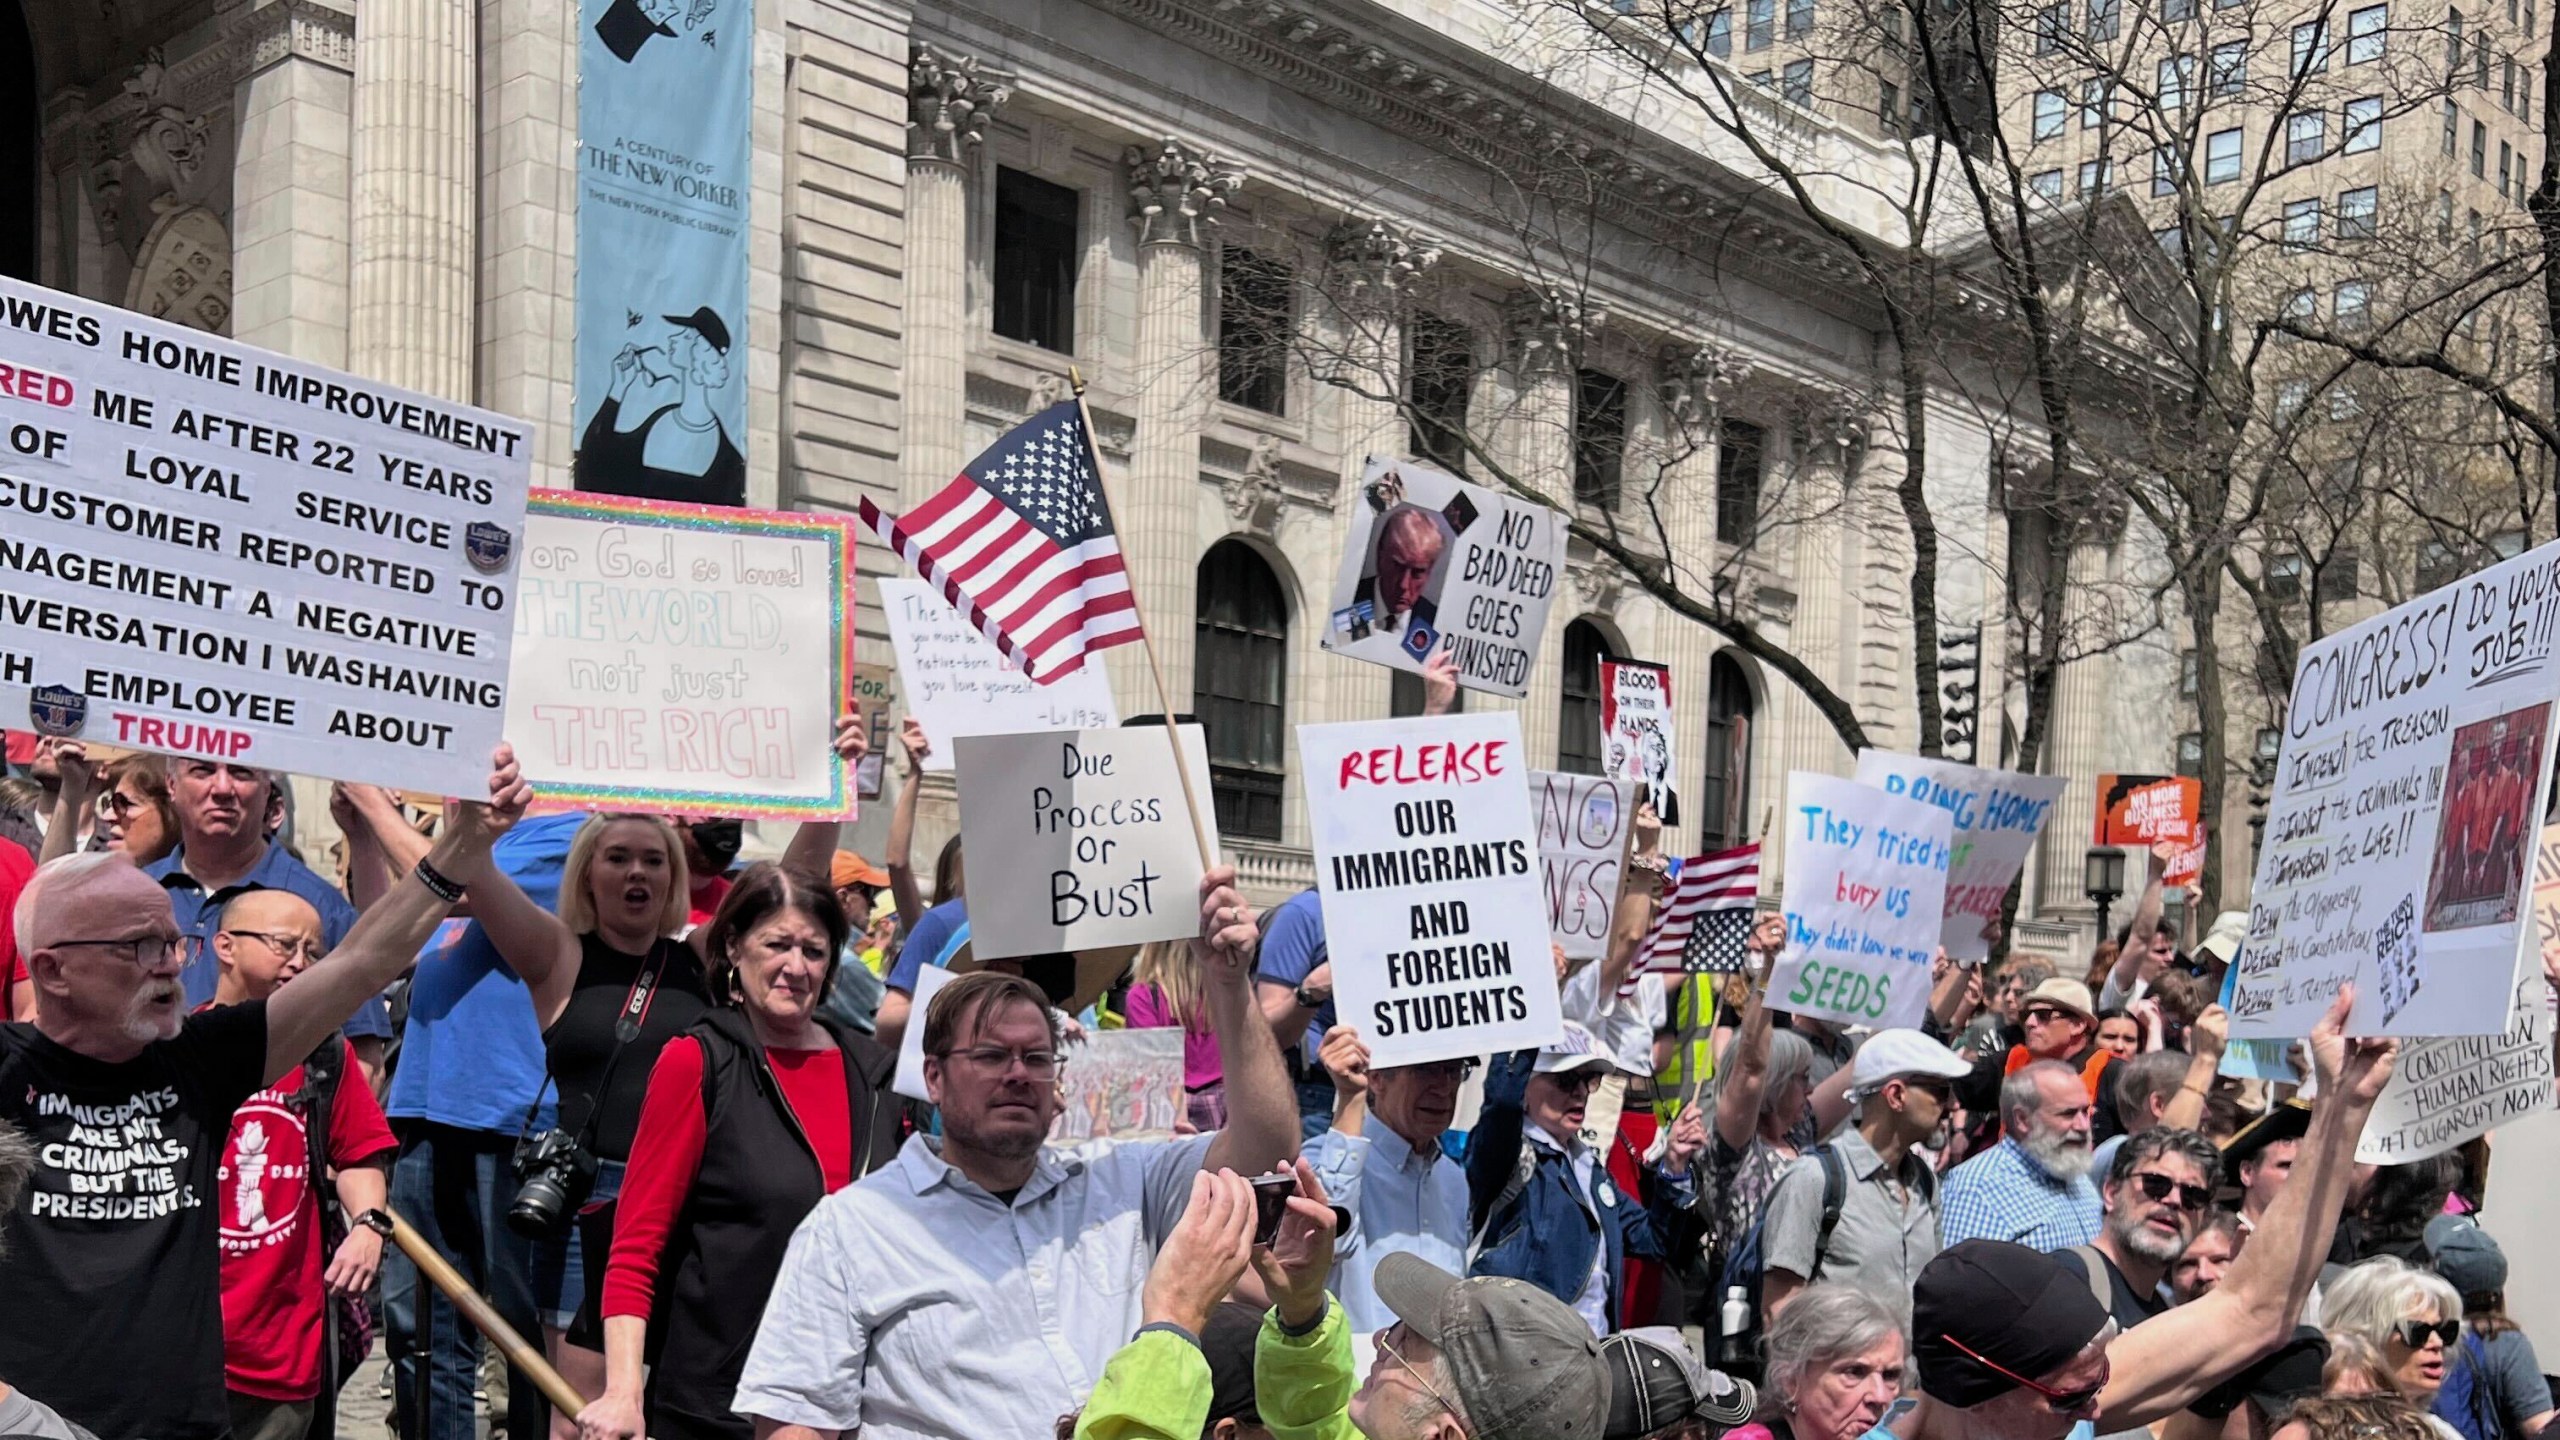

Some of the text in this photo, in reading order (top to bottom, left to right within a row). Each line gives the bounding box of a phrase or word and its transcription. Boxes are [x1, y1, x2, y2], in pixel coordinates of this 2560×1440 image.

[587, 146, 738, 210] THE NEW YORKER
[615, 137, 715, 175] A CENTURY OF
[588, 188, 738, 239] THE NEW YORK PUBLIC LIBRARY
[0, 297, 520, 457] WES HOME IMPROVEMENT
[93, 389, 153, 429] ME
[172, 409, 299, 461] AFTER
[312, 441, 354, 473] 22
[379, 454, 493, 505] YEARS
[11, 425, 451, 549] OF LOYAL SERVICE
[1497, 510, 1533, 551] NO
[239, 532, 435, 595] REPORTED
[460, 579, 504, 611] TO
[597, 527, 674, 578] God
[691, 558, 721, 581] so
[732, 540, 804, 587] loved
[1464, 544, 1553, 600] BAD DEED
[0, 594, 247, 665] VERSATION
[262, 644, 271, 670] I
[248, 591, 274, 619] A
[297, 601, 477, 657] NEGATIVE
[903, 594, 938, 622] The
[1467, 595, 1524, 639] GOES
[569, 650, 748, 701] not just
[1619, 671, 1656, 690] BLOOD
[2291, 588, 2459, 740] CONGRESS!
[2466, 582, 2497, 632] DO
[84, 669, 295, 726] EMPLOYEE
[328, 709, 453, 750] ABOUT
[922, 679, 945, 702] you
[952, 674, 979, 692] love
[113, 713, 253, 758] TRUMP
[534, 704, 796, 779] THE RICH
[1619, 714, 1659, 733] HANDS
[2382, 705, 2449, 751] TREASON
[1063, 743, 1116, 779] Due
[1340, 741, 1509, 790] RELEASE
[1034, 787, 1162, 836] Process
[1395, 799, 1457, 838] OUR
[1537, 774, 1620, 850] NO
[2124, 802, 2181, 827] BUSINESS
[2131, 784, 2182, 808] NO MORE
[1800, 807, 1864, 848] They
[1878, 827, 1933, 866] tried
[1331, 840, 1529, 892] IMMIGRANTS
[1052, 861, 1162, 926] Bust
[1539, 856, 1617, 940] NGS
[1836, 871, 1881, 913] bury
[1410, 900, 1470, 940] AND
[2377, 904, 2413, 964] REICH
[1387, 941, 1512, 988] FOREIGN
[1789, 960, 1891, 1019] SEEDS
[629, 985, 648, 1014] EOS
[1374, 986, 1527, 1038] STUDENTS
[2415, 1046, 2550, 1117] HUMAN RIGHTS
[41, 1139, 189, 1173] CRIMINALS,
[68, 1123, 122, 1148] ARE
[70, 1167, 176, 1193] BUT THE
